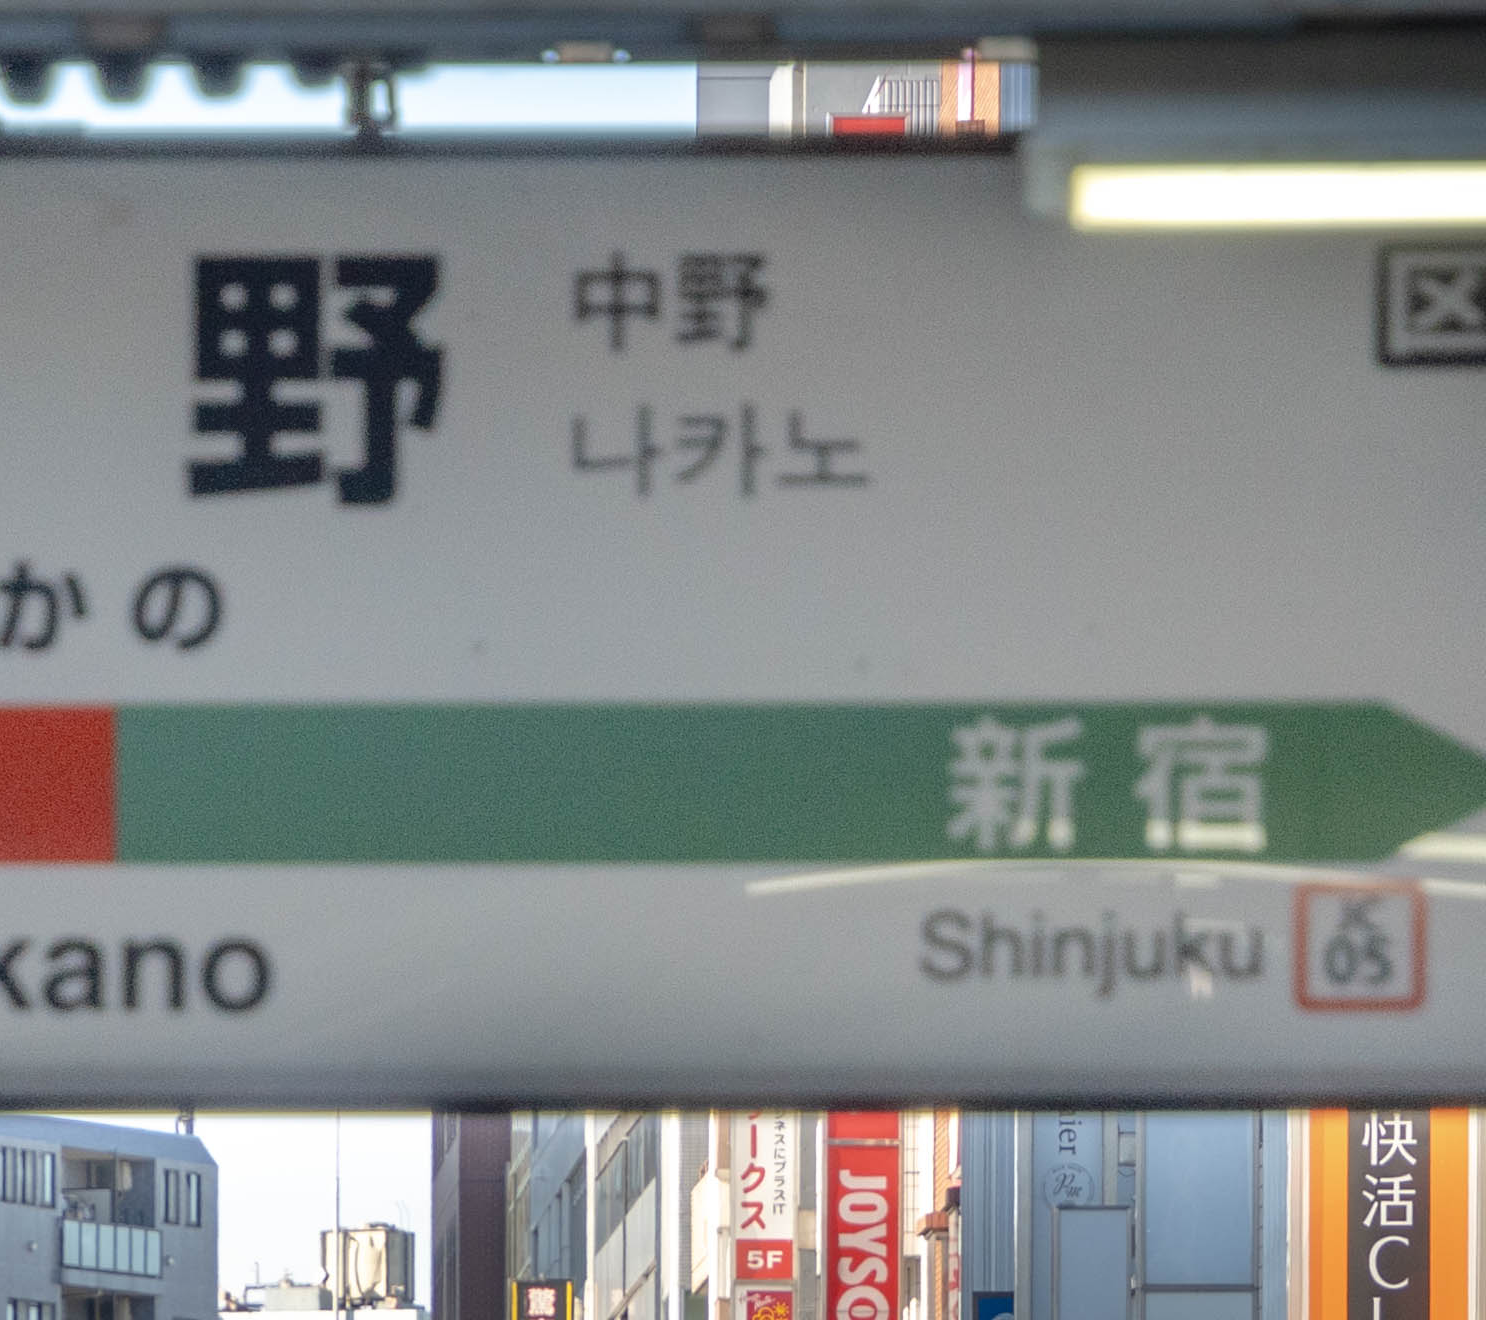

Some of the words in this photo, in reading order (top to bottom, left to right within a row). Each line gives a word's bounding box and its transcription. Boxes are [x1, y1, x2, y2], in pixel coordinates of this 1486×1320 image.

[573, 250, 769, 352] 中野
[571, 403, 870, 498] 나카노
[945, 715, 1269, 852] 新宿
[919, 908, 1266, 1002] Shinjuku
[1322, 931, 1395, 986] 05
[1058, 1110, 1083, 1156] ier
[746, 1250, 784, 1270] 5F
